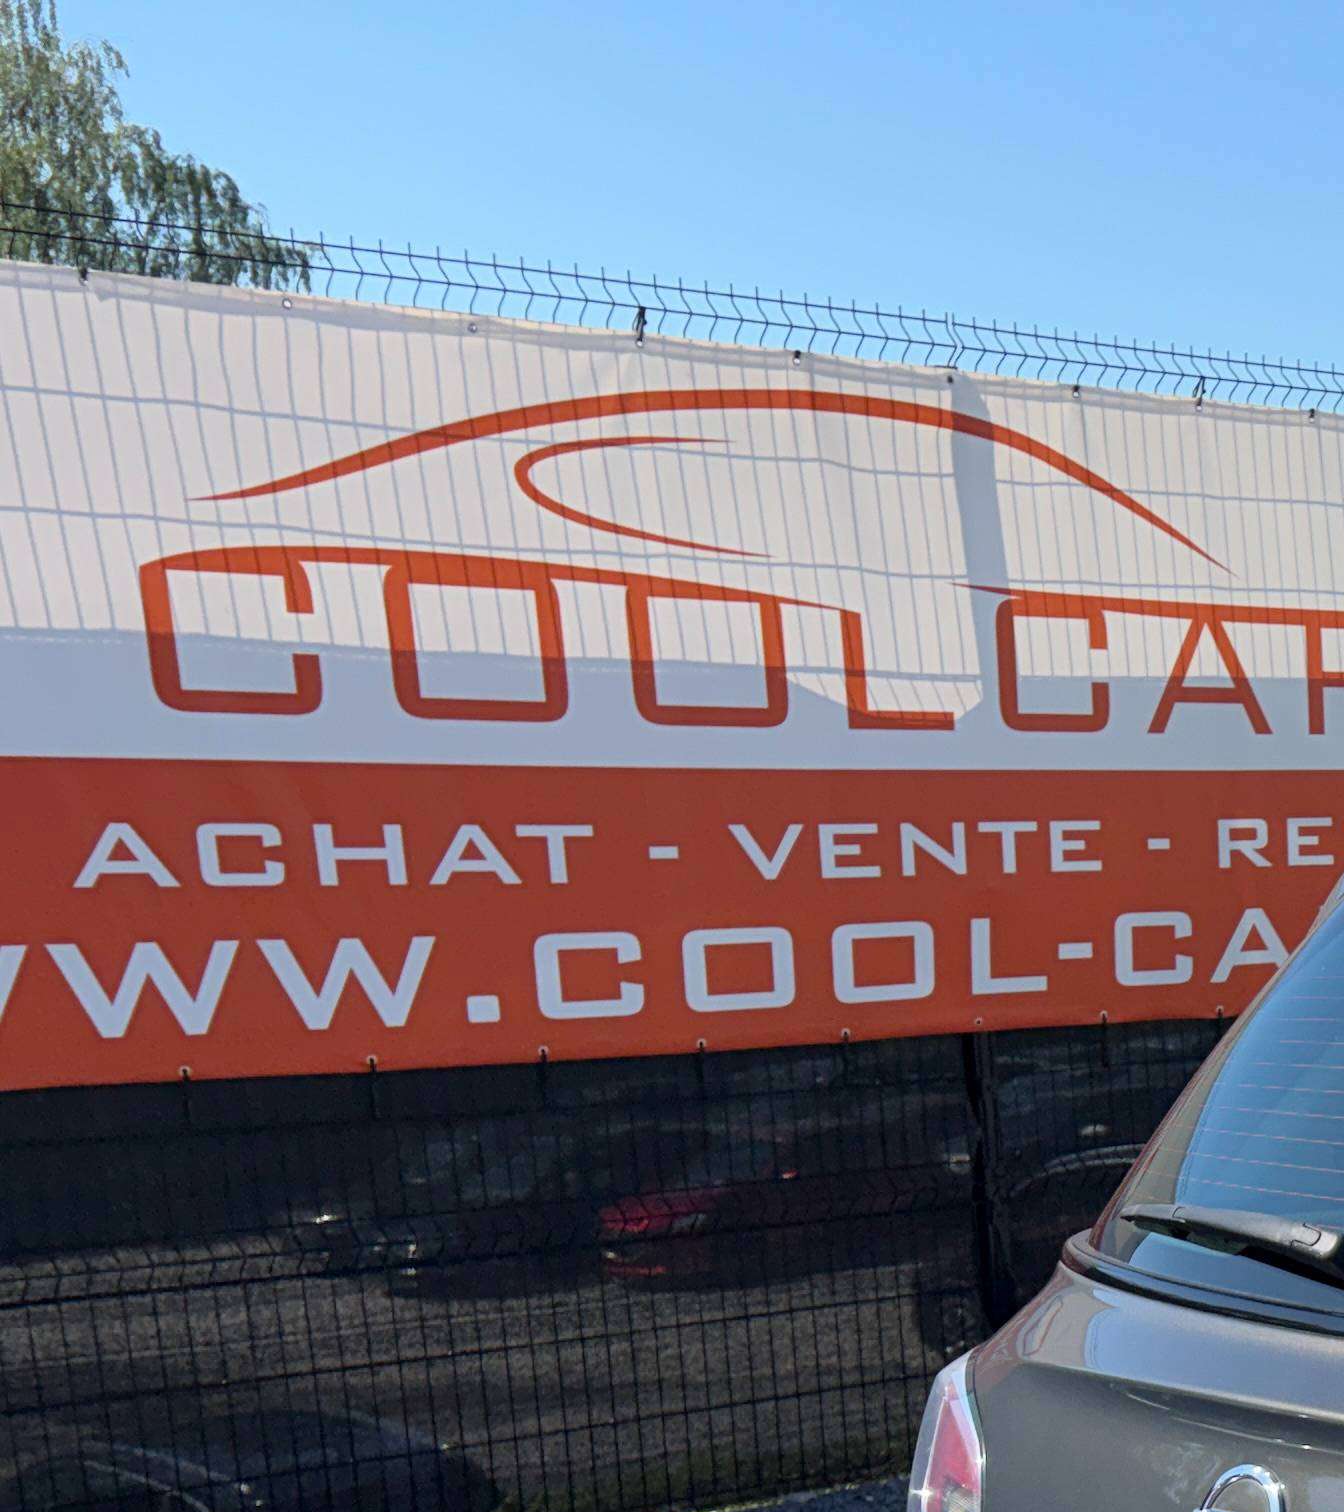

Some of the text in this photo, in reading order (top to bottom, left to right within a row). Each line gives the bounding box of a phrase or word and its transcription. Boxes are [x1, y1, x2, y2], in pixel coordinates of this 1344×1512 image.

[139, 546, 955, 730] COOL
[73, 822, 594, 888] ACHAT
[728, 819, 1103, 880] VENTE
